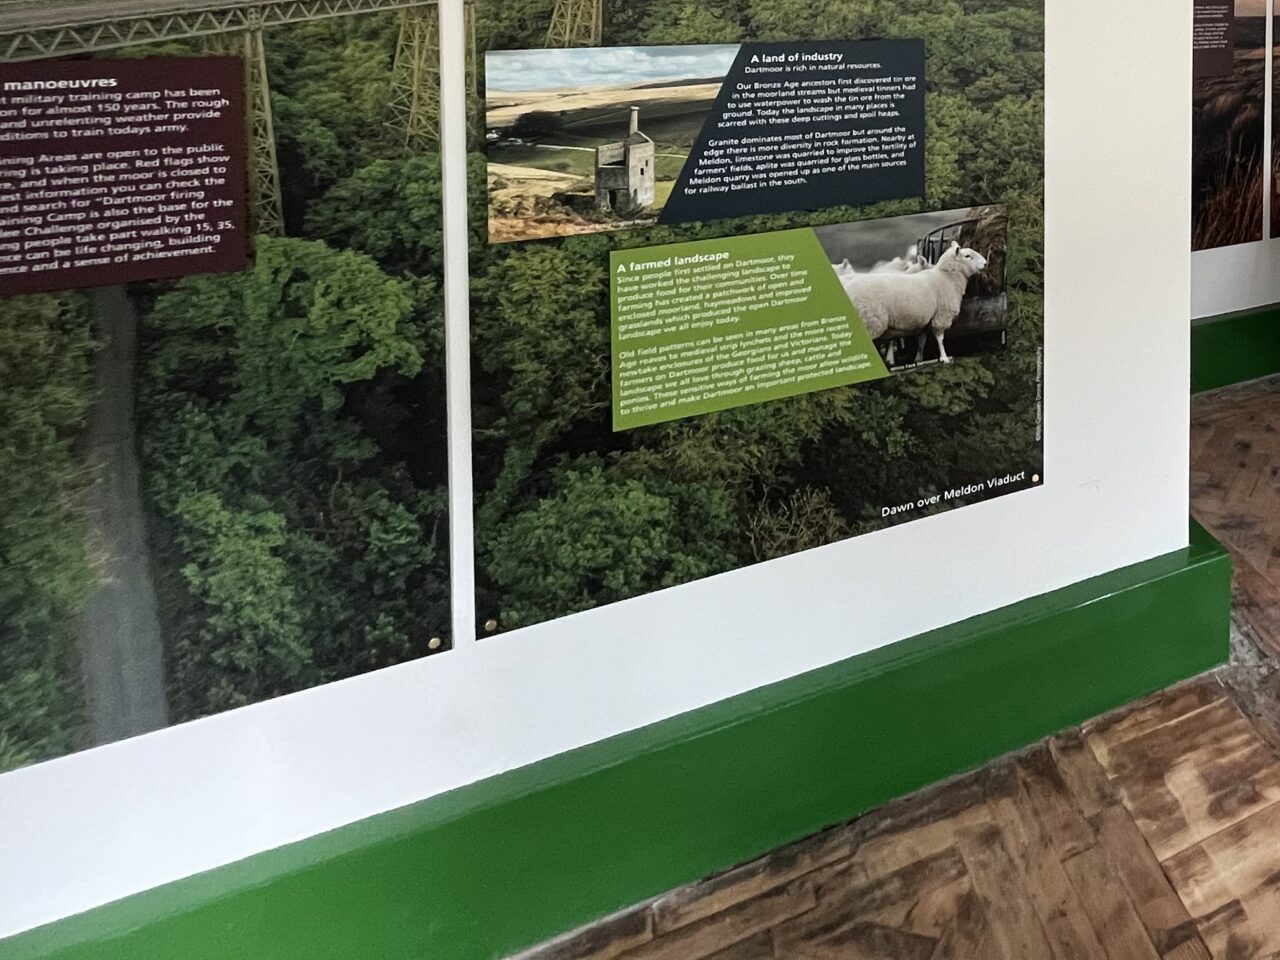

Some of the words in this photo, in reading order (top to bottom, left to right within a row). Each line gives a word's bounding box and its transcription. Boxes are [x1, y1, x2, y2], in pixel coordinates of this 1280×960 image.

[750, 54, 759, 62] A
[762, 53, 784, 62] land
[787, 53, 798, 61] of
[801, 52, 842, 63] industry
[744, 65, 782, 73] Dartmoor
[3, 77, 117, 90] manoeuvres
[753, 81, 781, 89] Bronze
[783, 80, 799, 89] Age
[11, 92, 64, 105] military
[68, 90, 122, 103] training
[125, 90, 160, 100] camp
[164, 88, 185, 97] has
[189, 87, 220, 96] been
[757, 89, 795, 97] moorland
[21, 105, 41, 115] for
[46, 103, 91, 114] almost
[98, 102, 120, 111] 150
[123, 102, 160, 112] years.
[166, 99, 188, 108] The
[191, 98, 229, 109] rough
[722, 109, 754, 119] ground.
[757, 108, 779, 117] Today
[796, 105, 833, 115] landscape
[844, 104, 864, 112] many
[865, 102, 887, 110] places
[753, 98, 800, 108] waterpower
[31, 114, 111, 128] unrelenting
[115, 112, 168, 122] weather
[173, 109, 221, 122] provide
[717, 119, 746, 127] scarred
[748, 117, 766, 125] with
[768, 116, 789, 124] these
[791, 115, 810, 124] deep
[812, 113, 842, 122] cuttings
[859, 111, 876, 119] spoil
[877, 109, 900, 118] heaps.
[53, 128, 67, 137] to
[71, 126, 103, 136] train
[107, 124, 150, 137] todays
[154, 124, 189, 134] army.
[617, 263, 625, 272] A
[629, 258, 670, 271] farmed
[674, 251, 729, 267] landscape
[881, 501, 914, 517] Dawn
[917, 494, 941, 508] over
[944, 483, 984, 500] Meldon
[987, 471, 1025, 488] Viaduct
